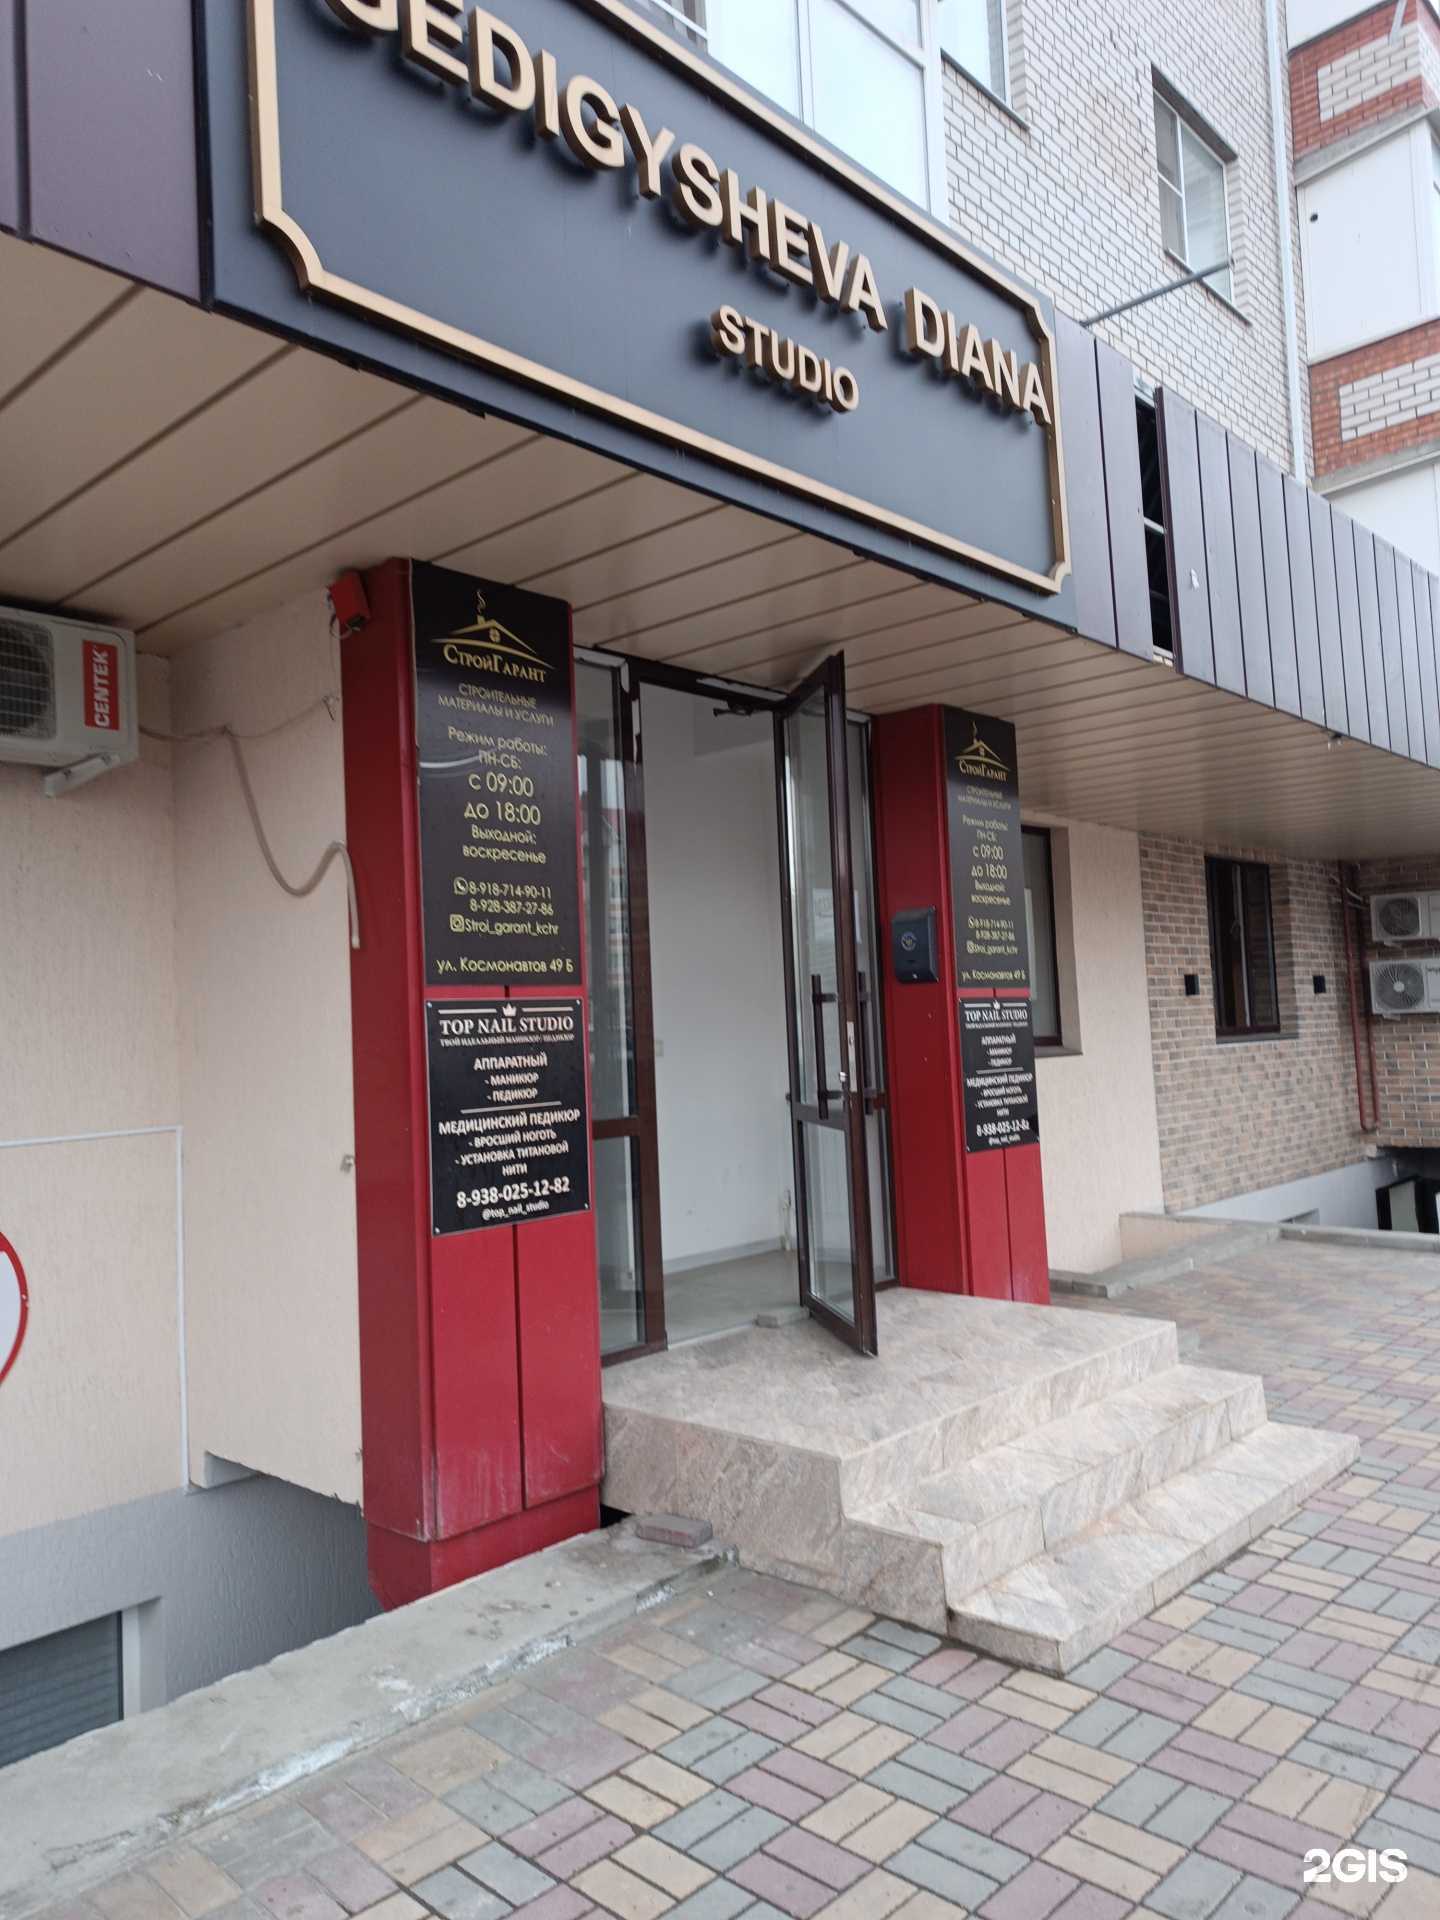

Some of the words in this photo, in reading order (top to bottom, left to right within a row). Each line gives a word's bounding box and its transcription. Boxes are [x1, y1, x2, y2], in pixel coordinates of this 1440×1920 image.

[324, 0, 887, 332] EDIGYSHEVA
[905, 288, 1052, 425] DIANA
[711, 304, 860, 413] STUDIO
[92, 646, 110, 728] CENTEK
[447, 726, 495, 746] Режим
[486, 771, 534, 797] 09:00
[495, 800, 541, 825] 18:00
[471, 824, 537, 845] Выходной:
[462, 845, 546, 865] воскресенье
[980, 843, 1004, 860] 09:00
[985, 863, 1008, 880] 18:00
[468, 880, 552, 899] 8-918-714-90-11
[436, 959, 456, 975] ул.
[460, 956, 547, 973] Космонавтов
[549, 958, 563, 973] 49
[439, 1019, 474, 1035] TOP
[477, 1017, 517, 1033] NAIL
[519, 1016, 574, 1032] STUDIO
[964, 1011, 981, 1022] TOP
[982, 1010, 1001, 1021] NAIL
[1002, 1009, 1028, 1021] STUDIO
[473, 1051, 548, 1071] АППАРАТНЫЙ
[438, 1111, 529, 1135] МЕДИЦИНСКИЙ
[529, 1108, 580, 1125] ПЕДИКЮР
[522, 1129, 557, 1142] НОГОТЬ
[516, 1140, 569, 1158] ТИТАНОВОЙ
[502, 1163, 528, 1177] НИТИ
[456, 1176, 571, 1209] 8-938-025-12-82
